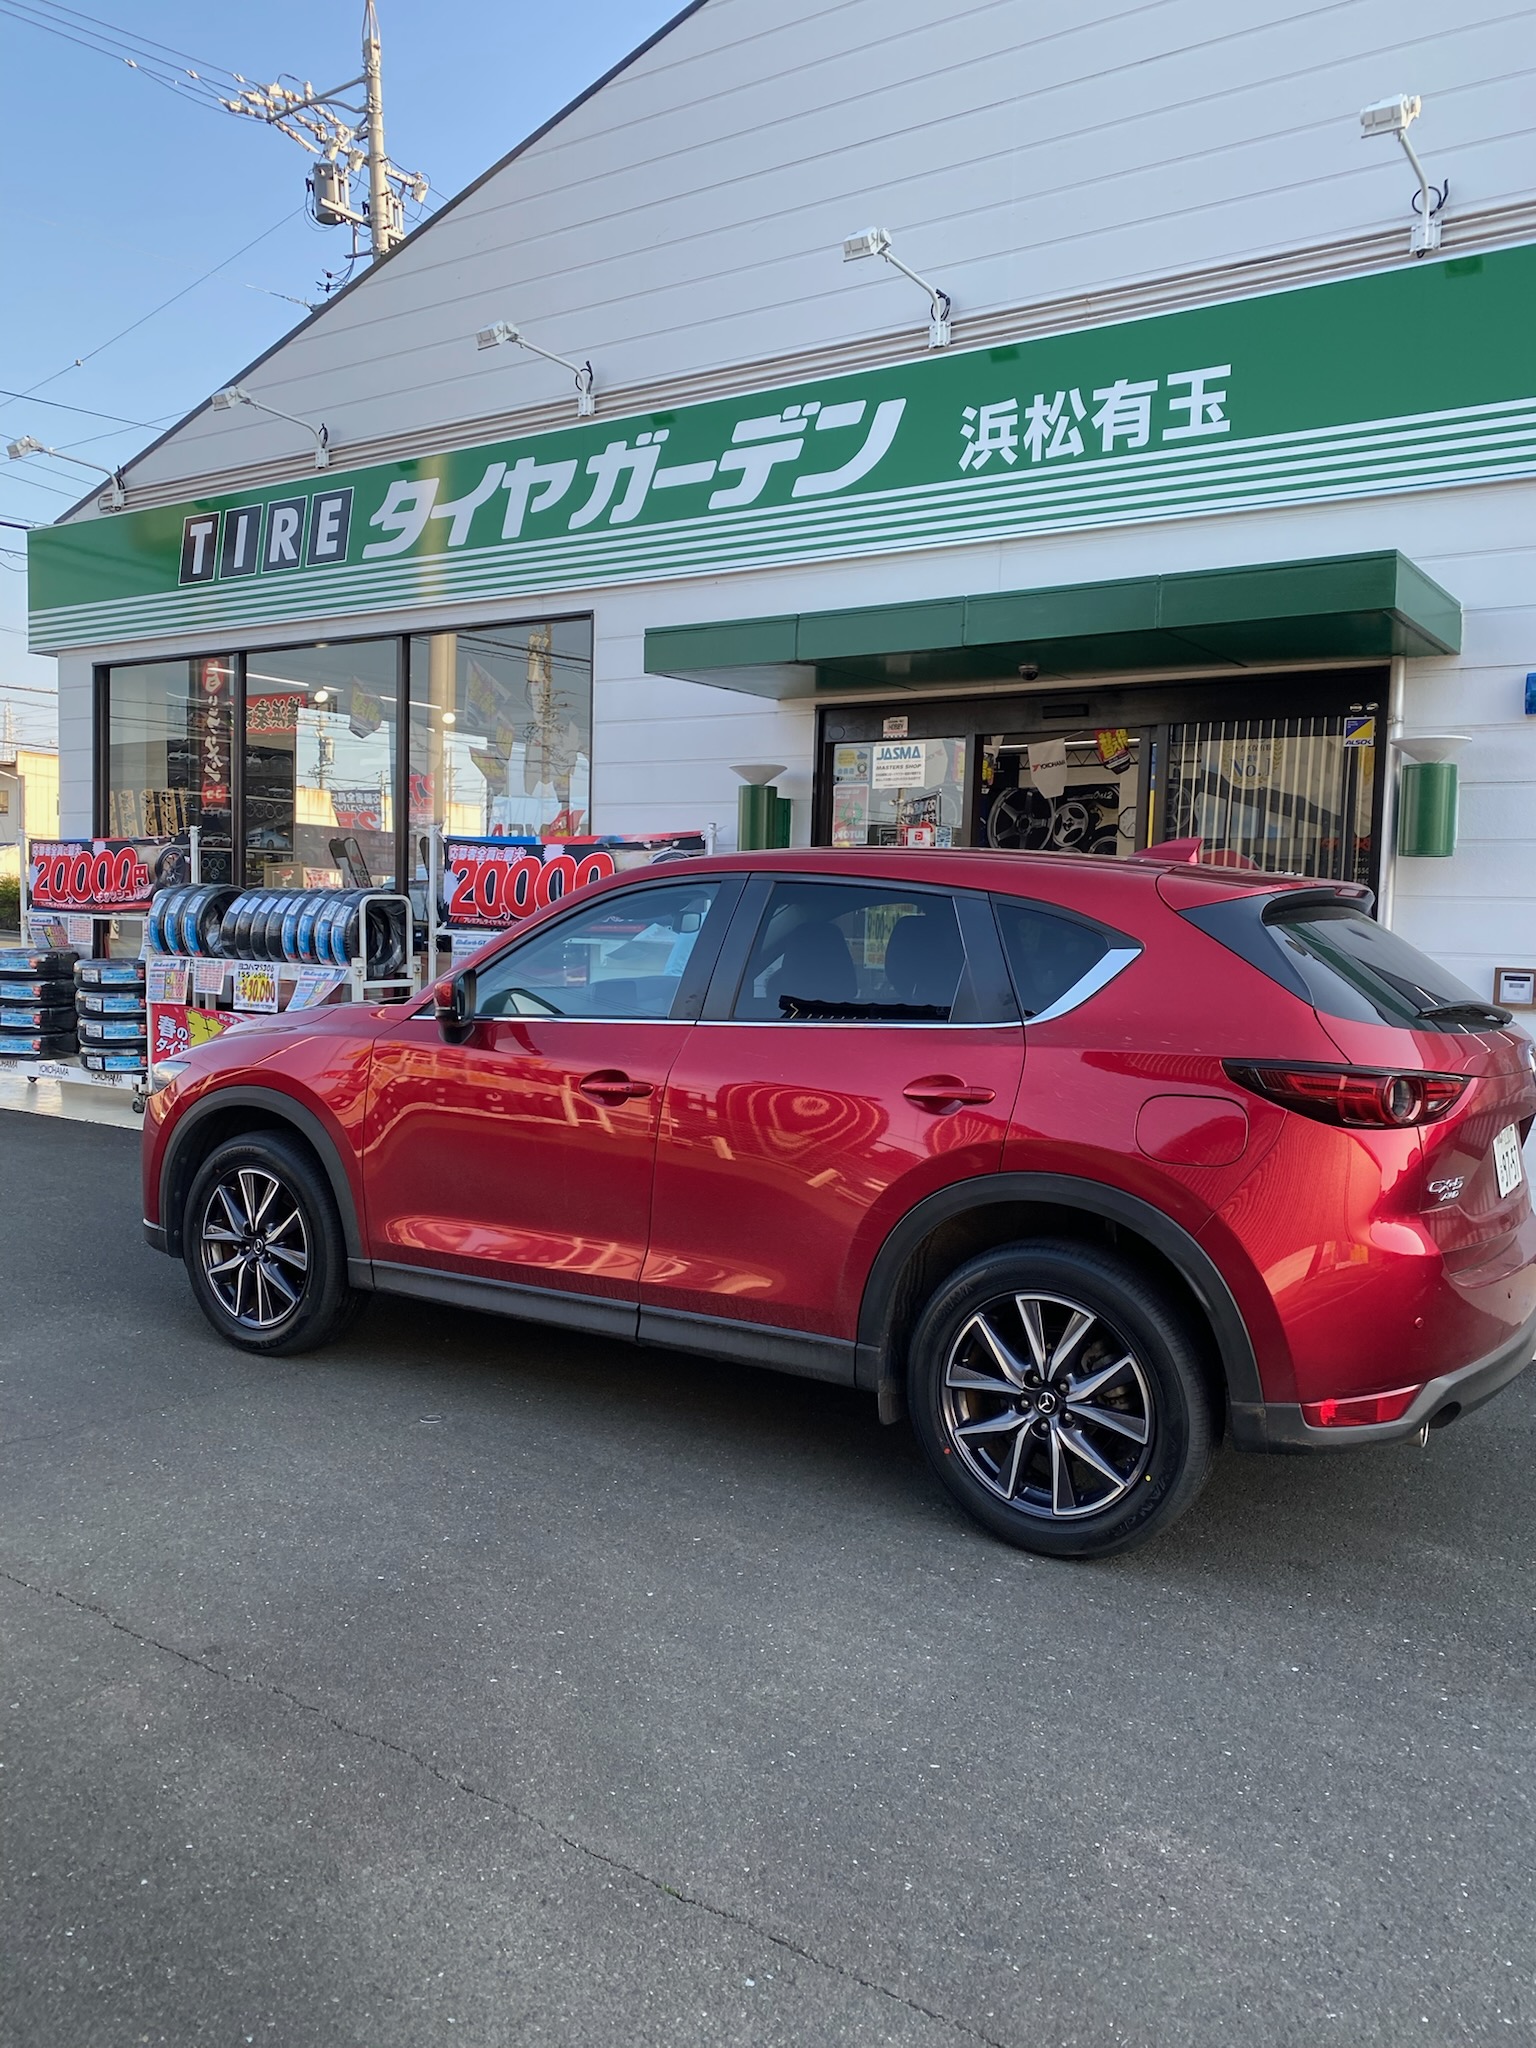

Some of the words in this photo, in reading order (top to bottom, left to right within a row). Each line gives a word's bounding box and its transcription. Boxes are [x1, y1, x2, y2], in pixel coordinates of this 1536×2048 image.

[188, 496, 344, 575] TIRE
[361, 397, 907, 560] タイヤガーデン
[957, 363, 1233, 472] 浜松有玉
[876, 746, 921, 760] JASMA
[448, 845, 527, 863] 応募者全員に最大
[157, 1014, 189, 1041] 春の
[155, 1037, 189, 1055] タイヤ
[39, 1064, 70, 1076] YOKOHAMA
[1428, 1176, 1464, 1194] CX-5
